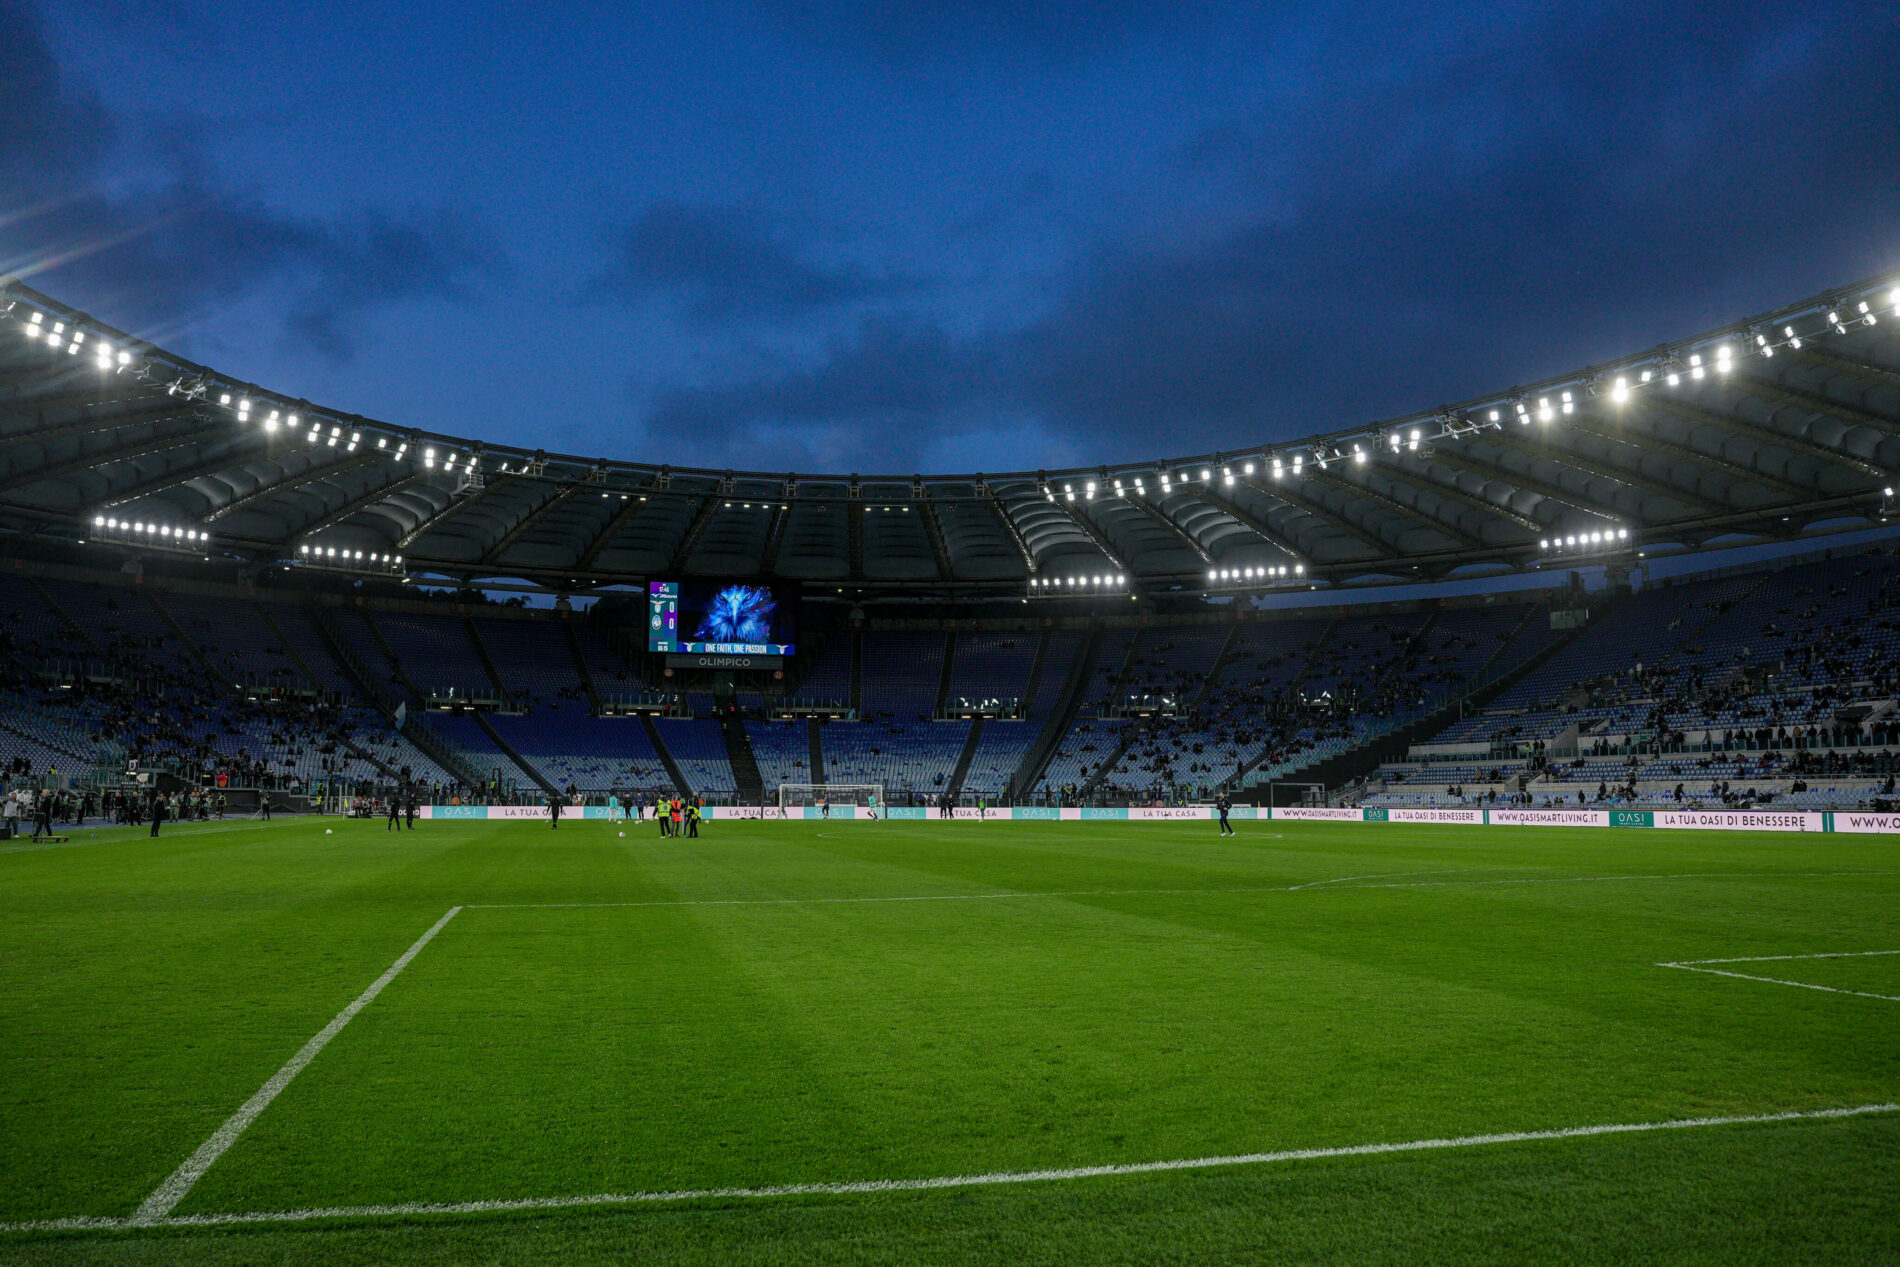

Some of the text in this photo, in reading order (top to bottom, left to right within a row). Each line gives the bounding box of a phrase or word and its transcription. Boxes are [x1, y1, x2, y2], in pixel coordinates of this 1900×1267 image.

[669, 601, 674, 613] 0
[669, 618, 674, 629] 0
[705, 643, 716, 653] ONE
[734, 644, 744, 653] ONE
[745, 644, 767, 654] PASSION
[699, 657, 751, 667] OLIMPICO
[505, 808, 516, 816] LA
[519, 808, 539, 816] TUA
[1415, 812, 1429, 820] OASI
[1430, 812, 1437, 820] DI
[1439, 812, 1474, 821] BENESSERE
[1497, 813, 1598, 823] WWW.OASISMARTLIVING.IT
[1618, 813, 1645, 822] OASI
[1665, 815, 1806, 827] LA TUA OASI DI BENESSERE
